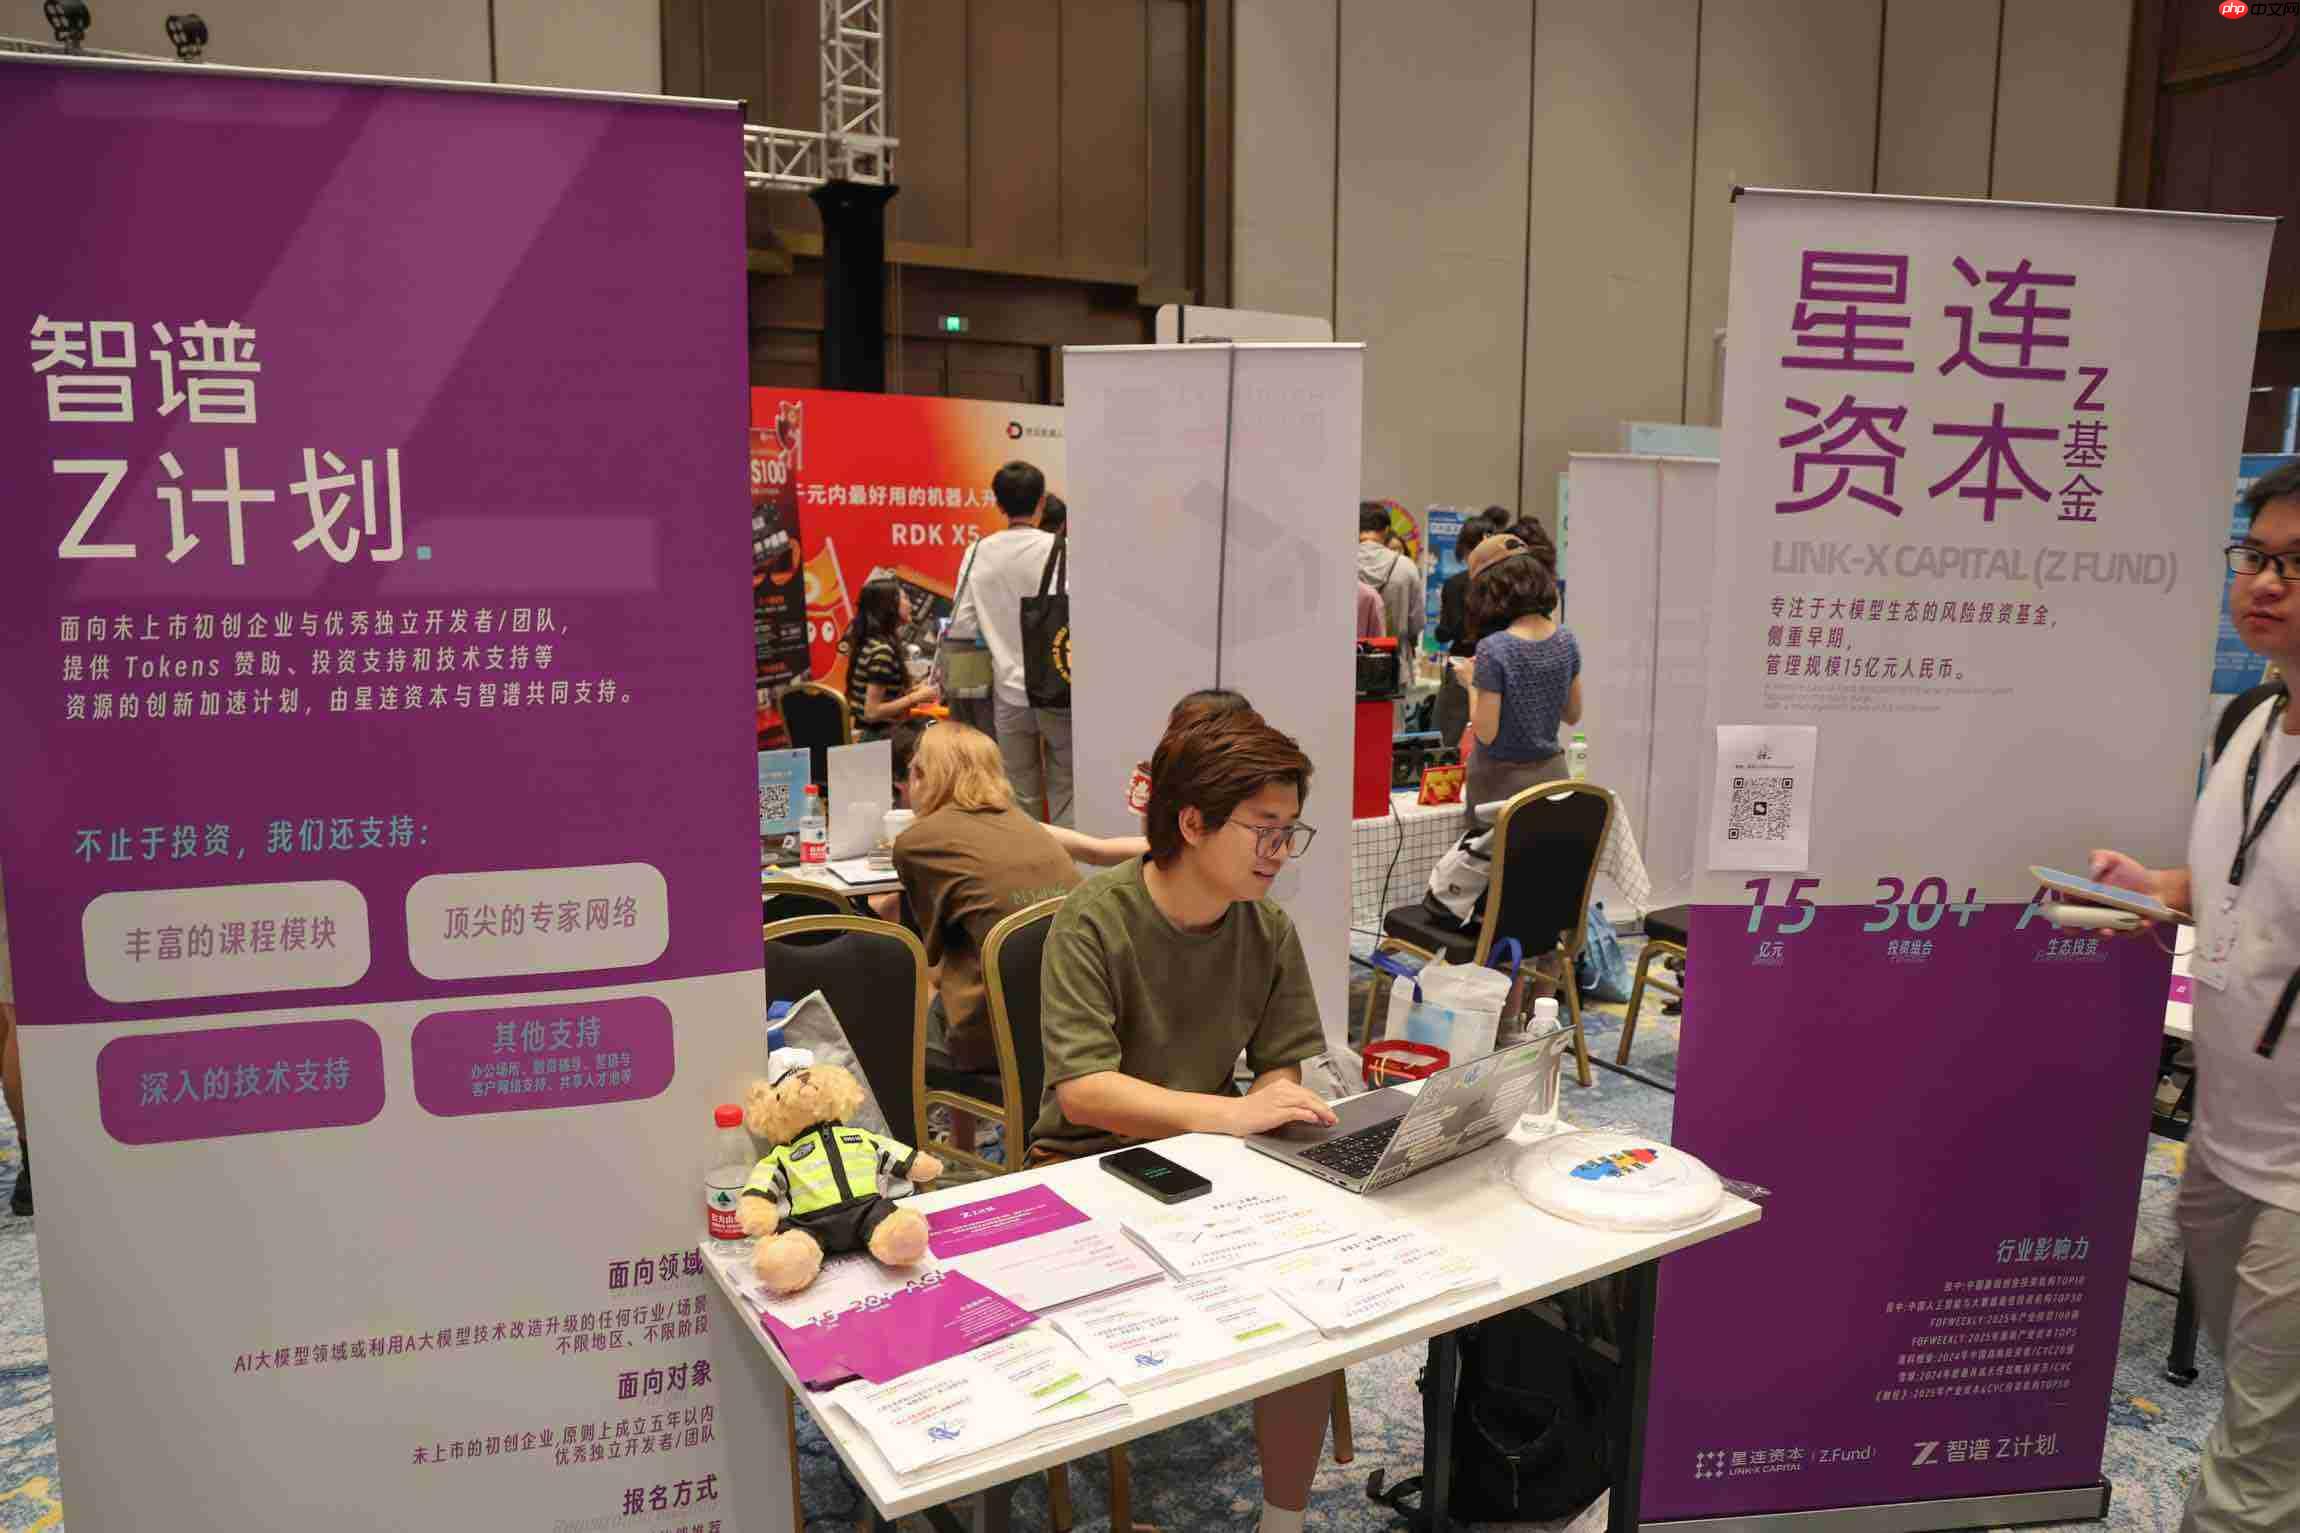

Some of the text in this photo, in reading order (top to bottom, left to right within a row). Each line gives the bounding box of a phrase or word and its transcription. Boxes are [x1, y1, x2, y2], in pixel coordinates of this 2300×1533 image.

[1782, 250, 2076, 381] 星连
[30, 314, 261, 424] 智谱
[1775, 394, 2060, 522] 资本
[2057, 366, 2108, 522] Z基金
[892, 524, 980, 545] RDK X5
[1895, 545, 2029, 582] CAPITAL
[62, 643, 554, 681] 提供 Tokens 赞助、投资支持和技术支持等
[443, 895, 639, 940] 顶尖的专家网络
[1743, 877, 1820, 935] 15
[1863, 877, 1985, 933] 30+
[123, 915, 337, 963] 丰富的课程模块
[1759, 941, 1784, 958] 亿元
[493, 1016, 602, 1054] 其他支持
[138, 1057, 352, 1108] 深入的技术支持
[608, 1248, 704, 1289] 面向领域
[1997, 1236, 2088, 1263] 行业影响力
[555, 1317, 710, 1355] 不限地区、不限阶段
[617, 1360, 712, 1399] 面向对象
[553, 1425, 715, 1466] 优秀独立开发者/团队
[1731, 1448, 1806, 1466] 星连资本
[1946, 1438, 1993, 1462] 智谱
[623, 1473, 718, 1515] 报名方式
